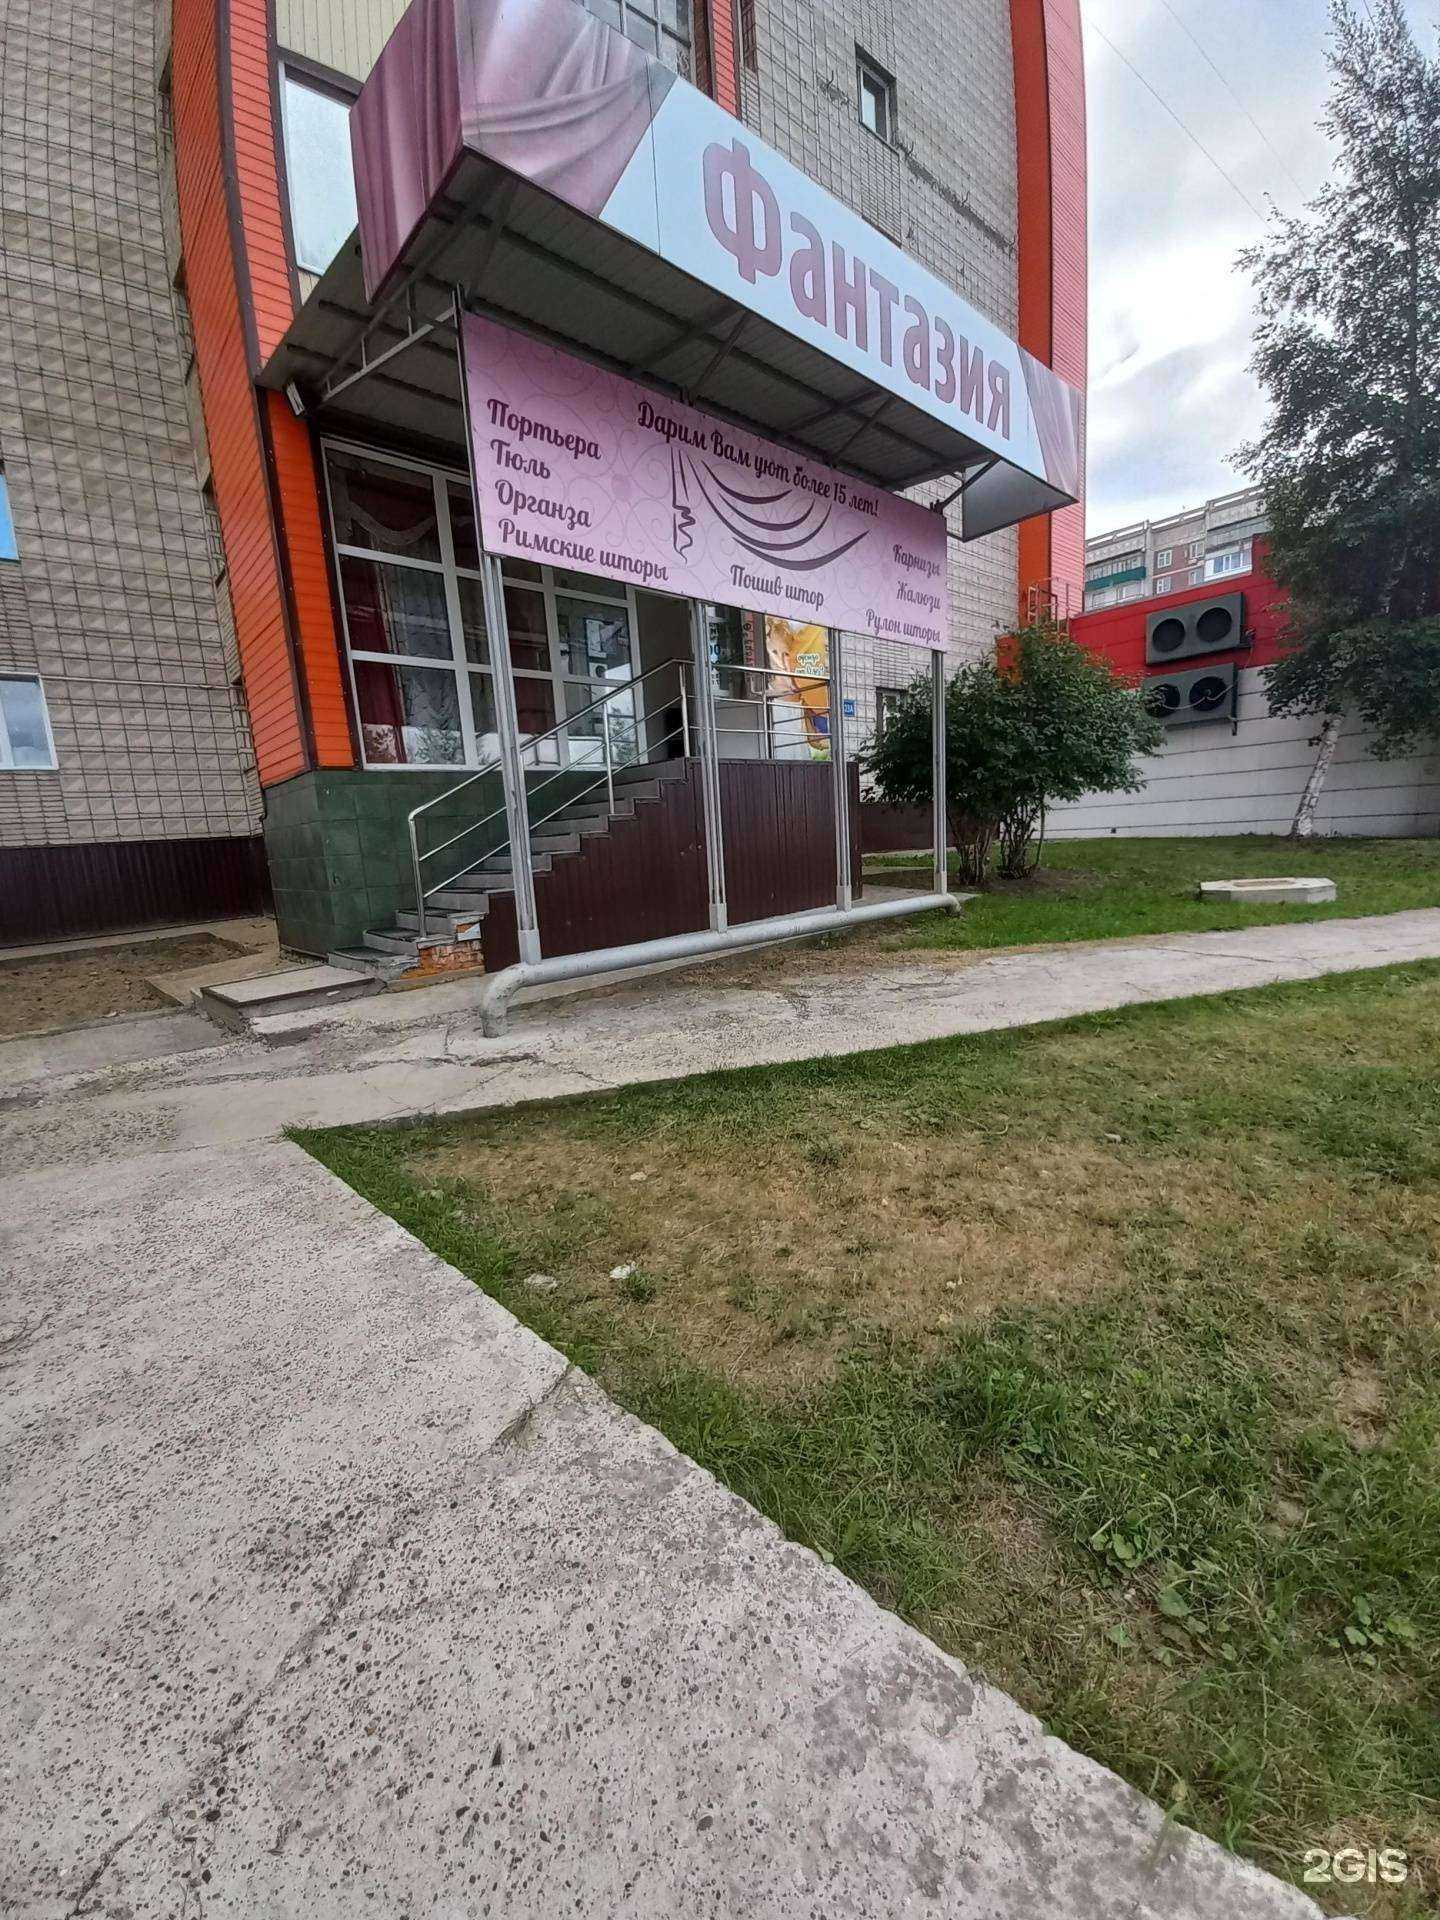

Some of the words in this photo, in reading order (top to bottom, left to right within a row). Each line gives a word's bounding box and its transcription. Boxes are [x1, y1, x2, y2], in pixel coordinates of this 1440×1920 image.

[702, 137, 1011, 440] Фантазия
[487, 399, 601, 460] Портьера
[490, 439, 550, 479] Тюль
[638, 401, 707, 450] Дарим
[711, 429, 751, 468] Вам
[754, 455, 791, 483] уют
[793, 466, 830, 499] более
[833, 482, 847, 505] 15
[849, 498, 879, 517] лет!
[495, 479, 591, 530] Органза
[498, 518, 595, 563] Римские
[600, 550, 668, 582] шторы
[893, 544, 940, 578] Карнизы
[730, 564, 782, 597] Пошив
[785, 584, 824, 611] штор
[896, 580, 940, 613] Жалюзи
[866, 608, 901, 635] Рулон
[903, 625, 940, 644] шторы
